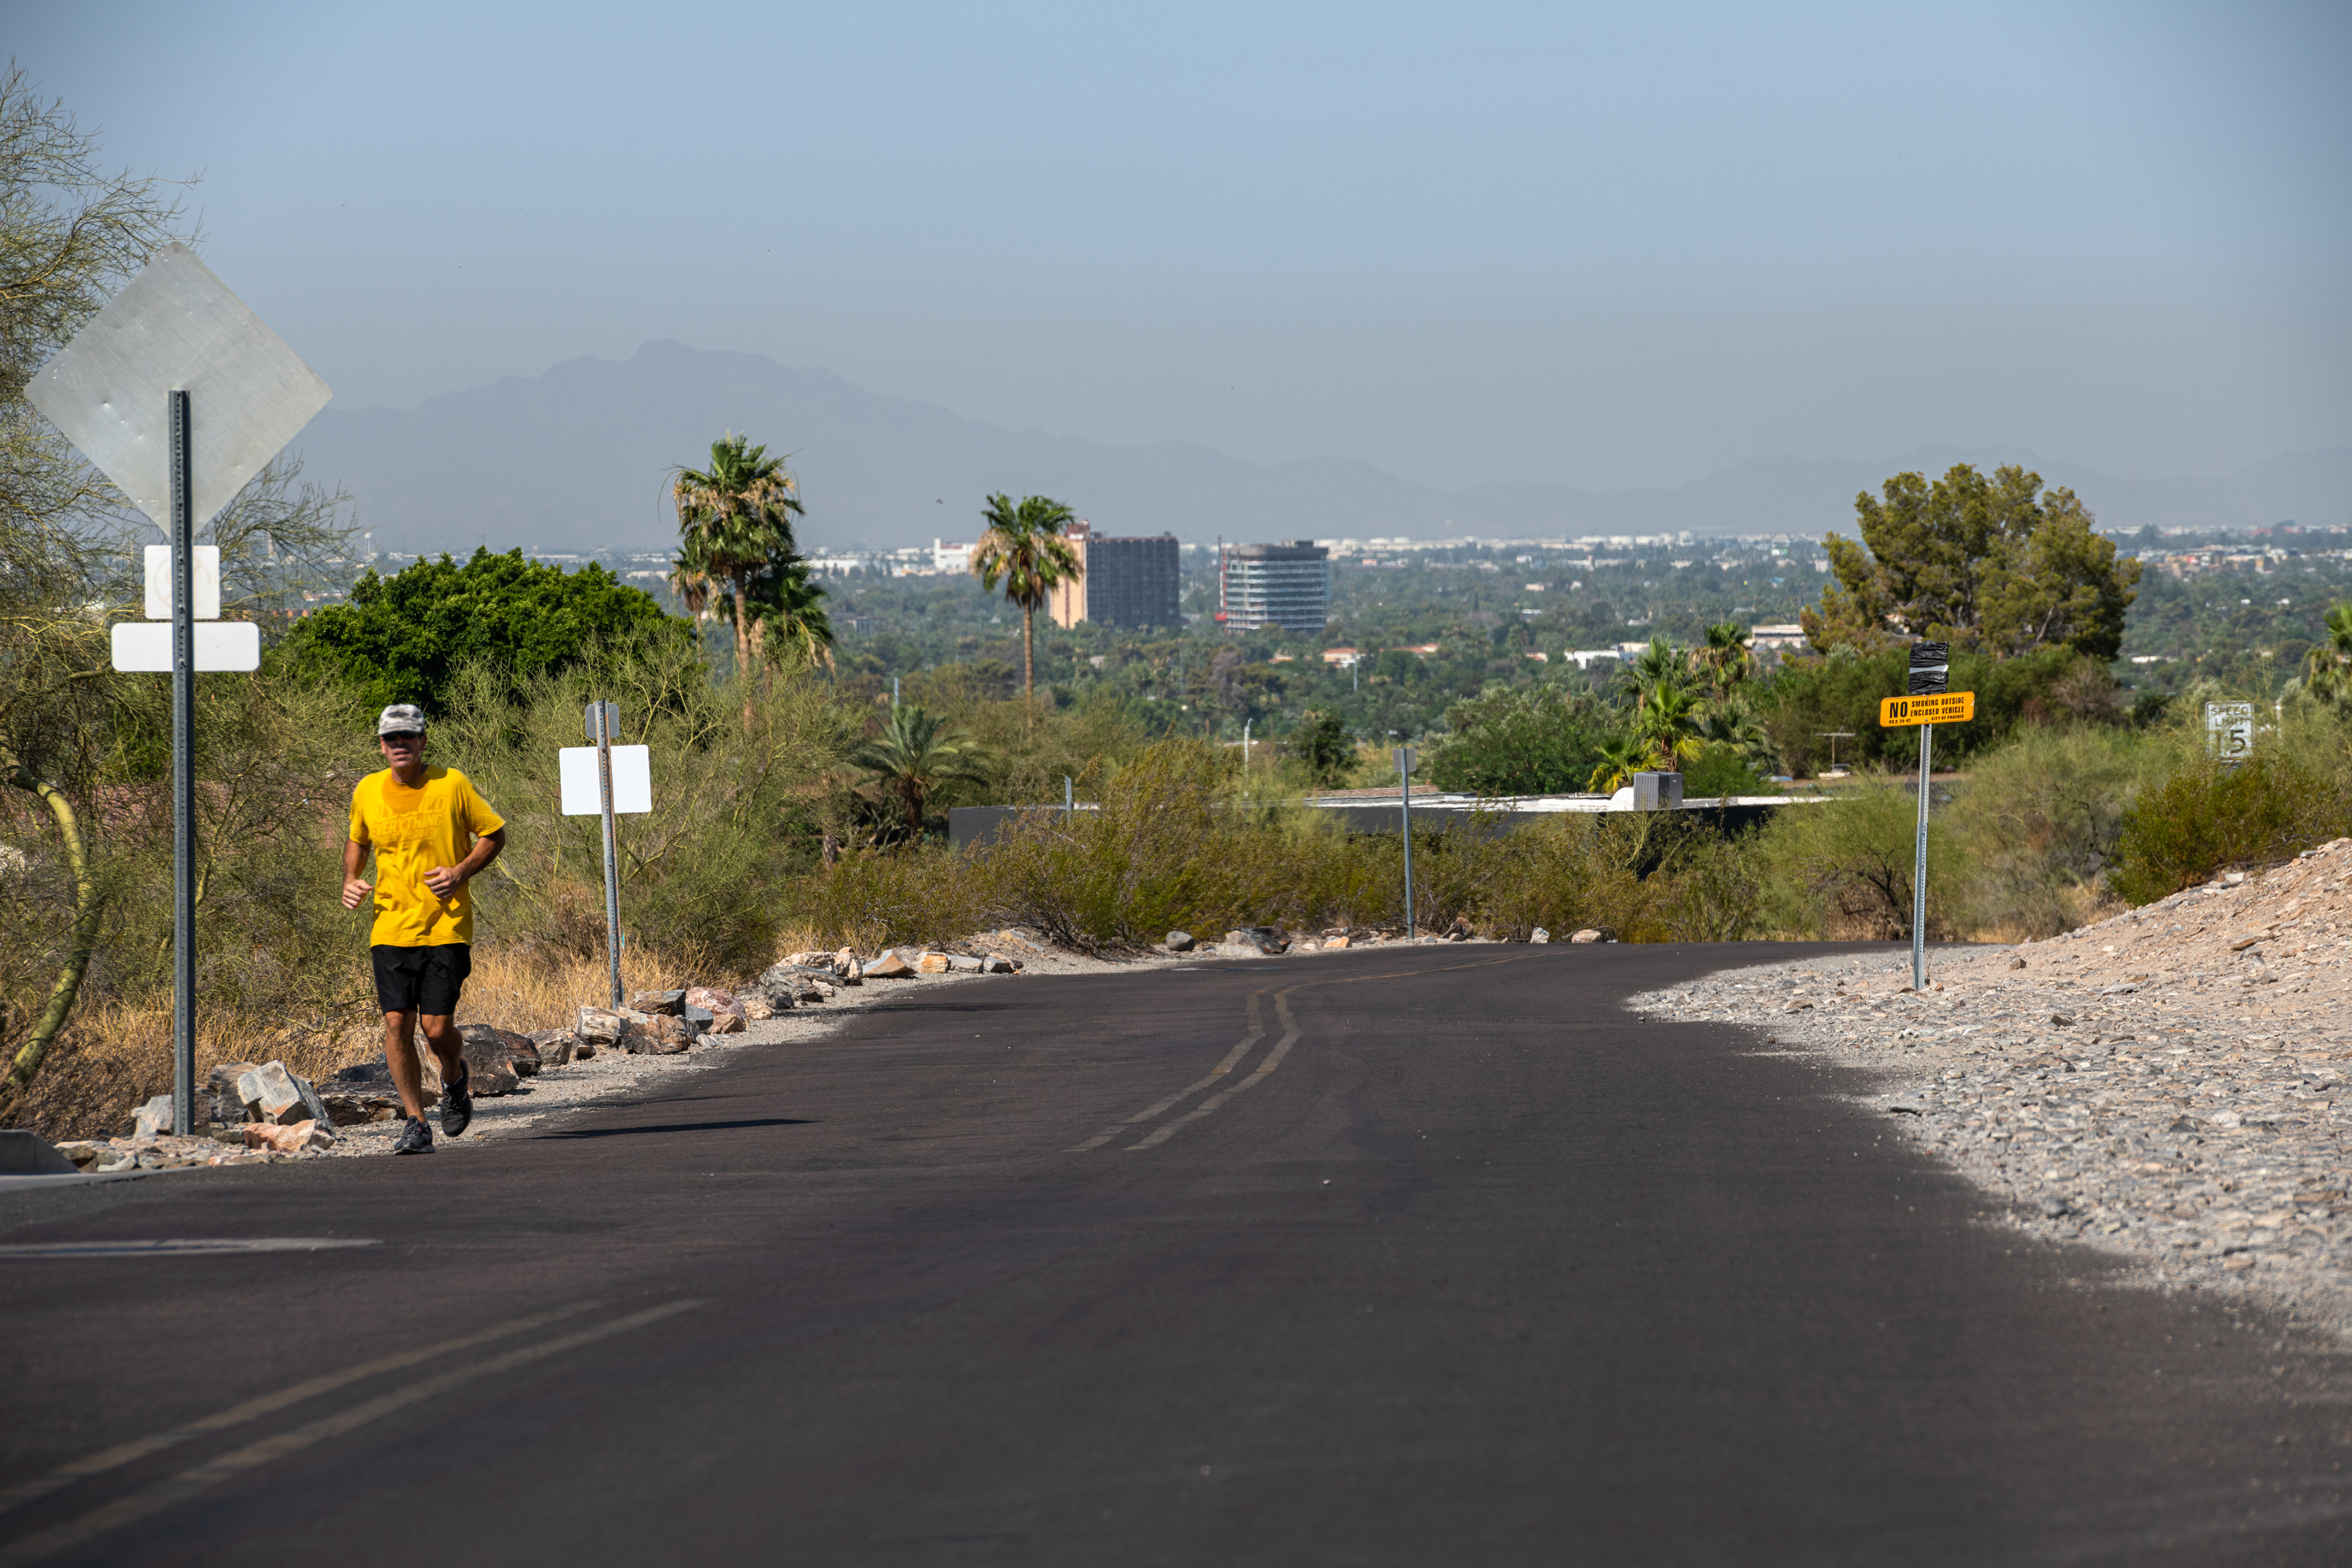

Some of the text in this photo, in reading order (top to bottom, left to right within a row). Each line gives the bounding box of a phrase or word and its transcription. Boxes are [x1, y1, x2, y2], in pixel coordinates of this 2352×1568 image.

[1912, 699, 1938, 708] SMOKING
[1889, 702, 1908, 718] NO
[1910, 708, 1939, 717] ENCLOSED
[2212, 706, 2248, 715] SPEED
[2215, 717, 2244, 727] LIMIT
[2215, 729, 2246, 753] 15
[371, 813, 444, 838] EVERYTHING
[413, 827, 435, 838] 2017
